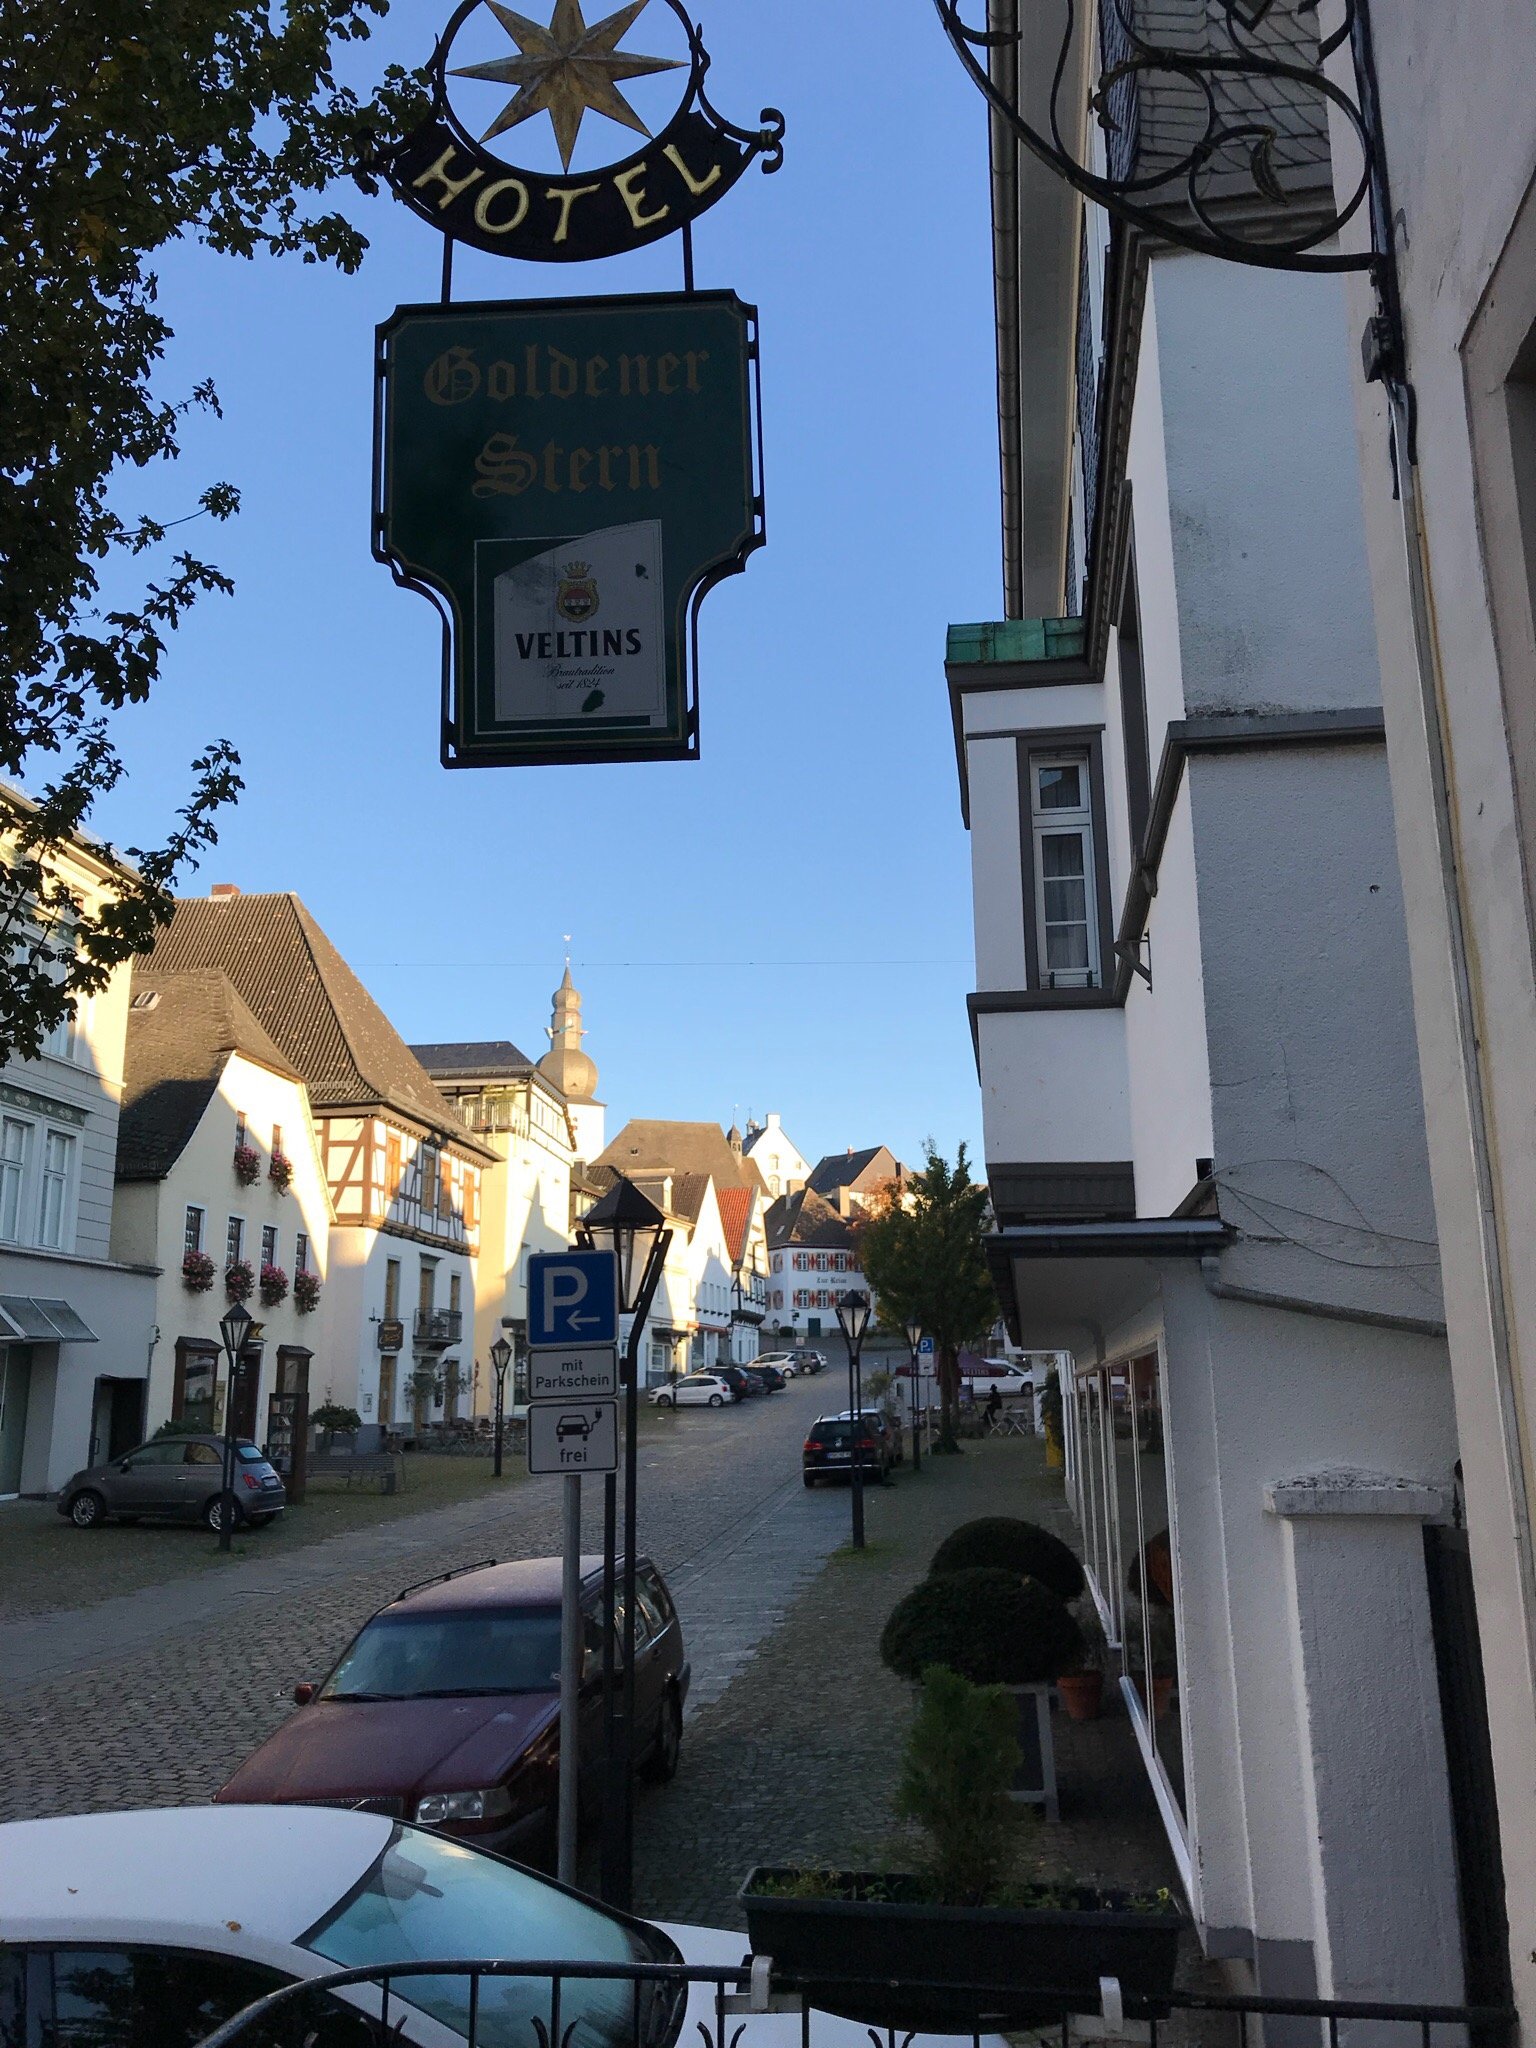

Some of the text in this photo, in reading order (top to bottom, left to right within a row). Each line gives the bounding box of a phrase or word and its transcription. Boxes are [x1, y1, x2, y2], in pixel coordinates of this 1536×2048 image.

[412, 143, 721, 244] HOTEL
[423, 344, 711, 406] Goldener
[471, 431, 662, 499] Stern
[515, 629, 642, 659] VELTINS
[543, 663, 615, 678] Brautradition
[557, 678, 600, 689] seit 1824
[544, 1266, 588, 1332] P
[920, 1340, 929, 1352] P
[561, 1359, 583, 1372] mit
[535, 1373, 610, 1389] Parkschein
[560, 1449, 588, 1463] frei
